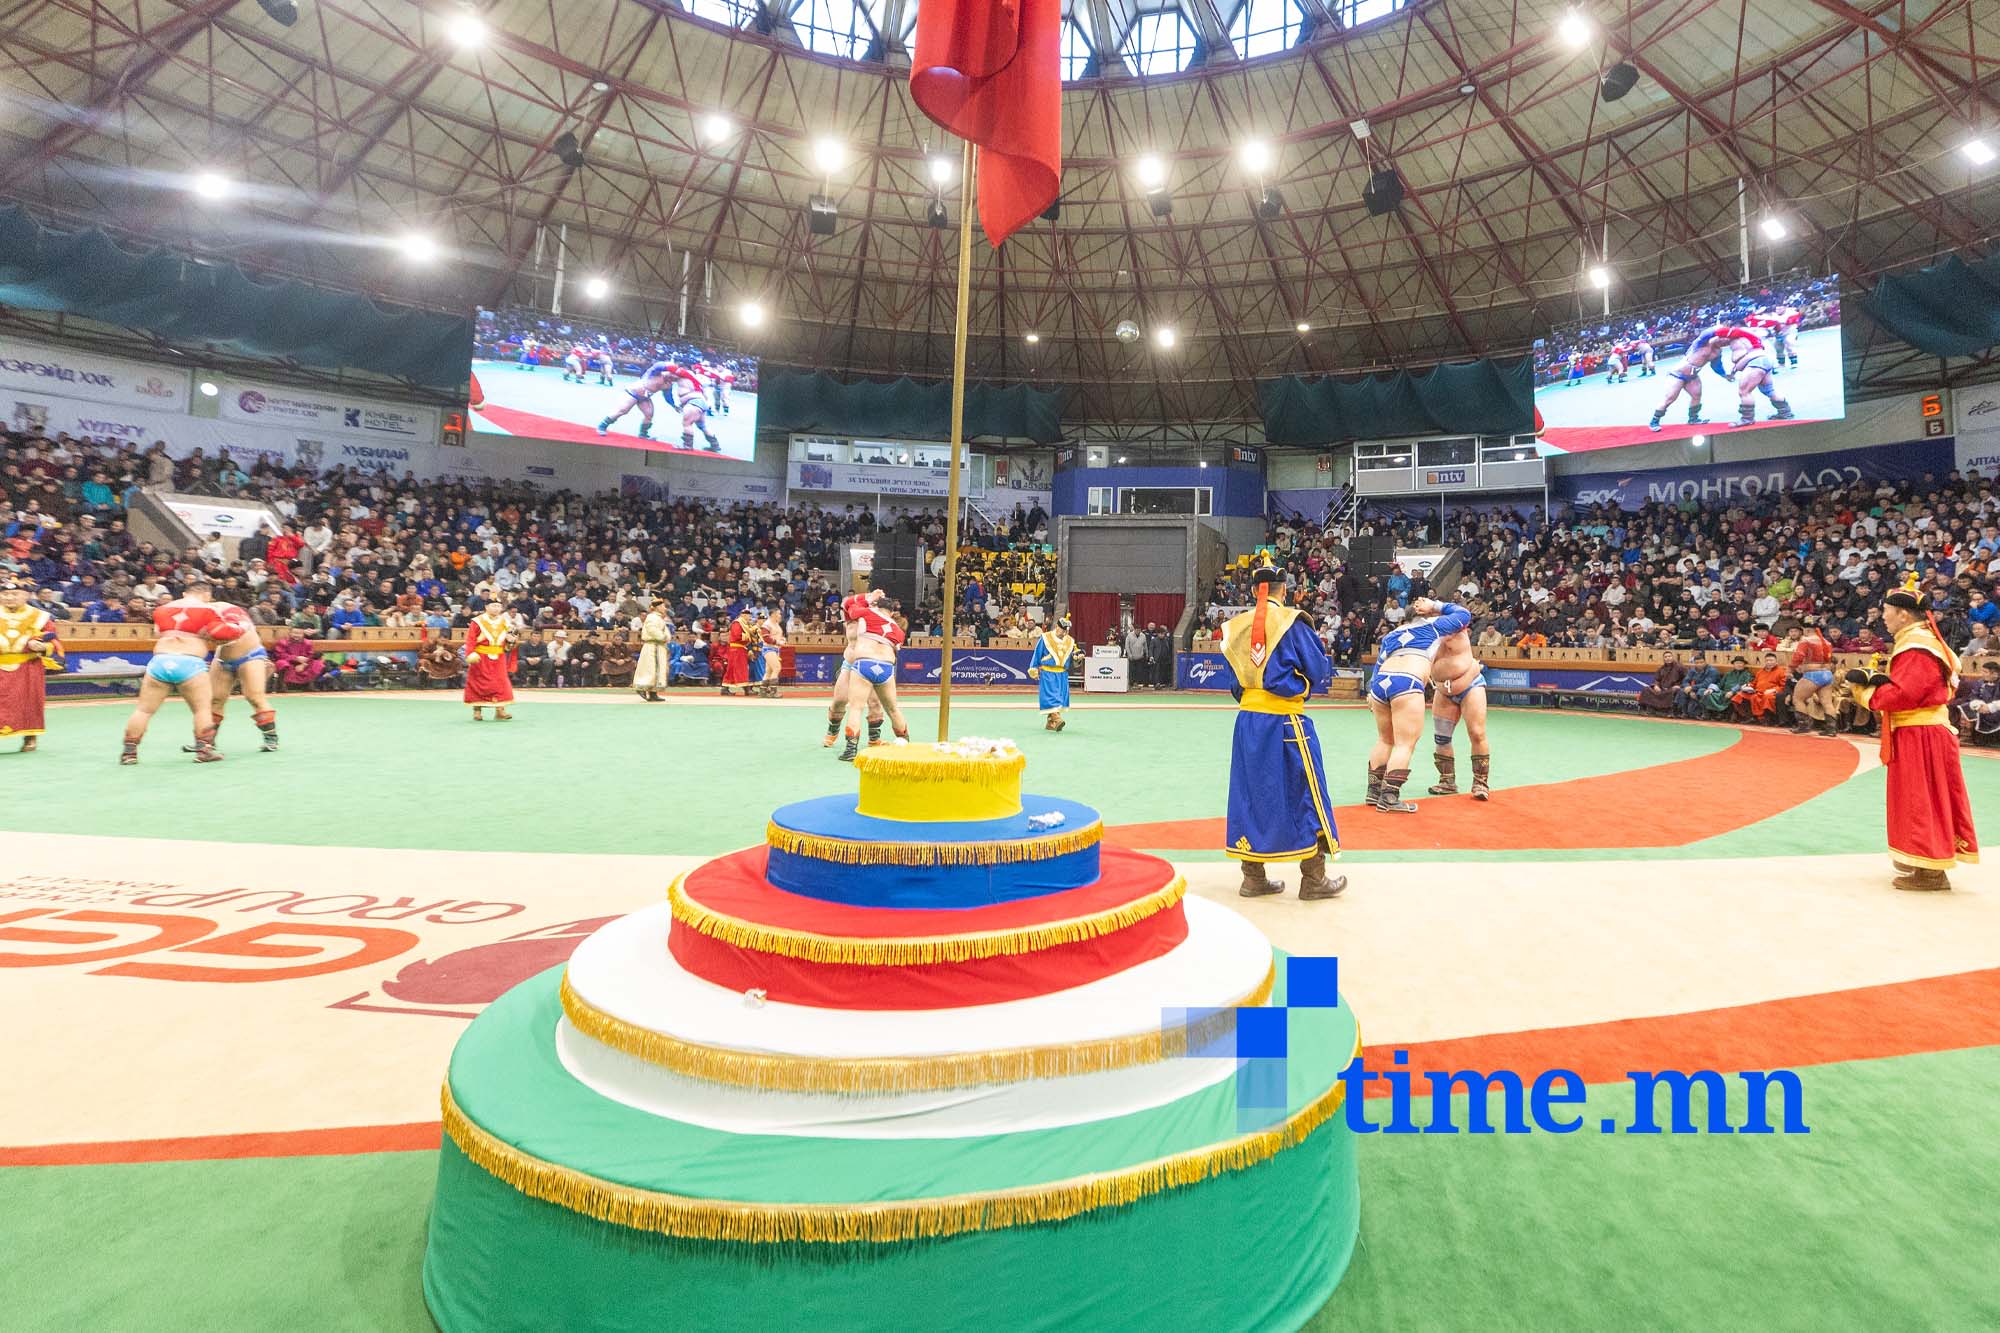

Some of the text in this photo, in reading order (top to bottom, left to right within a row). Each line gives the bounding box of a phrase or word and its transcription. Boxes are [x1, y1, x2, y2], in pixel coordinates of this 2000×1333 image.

[1921, 394, 1943, 416] Б
[342, 444, 410, 461] ХУБИЛАЙ
[1240, 449, 1257, 462] ntv
[1439, 471, 1464, 483] ntv
[1648, 472, 1785, 503] МОНГОЛ
[131, 888, 526, 924] GROUP
